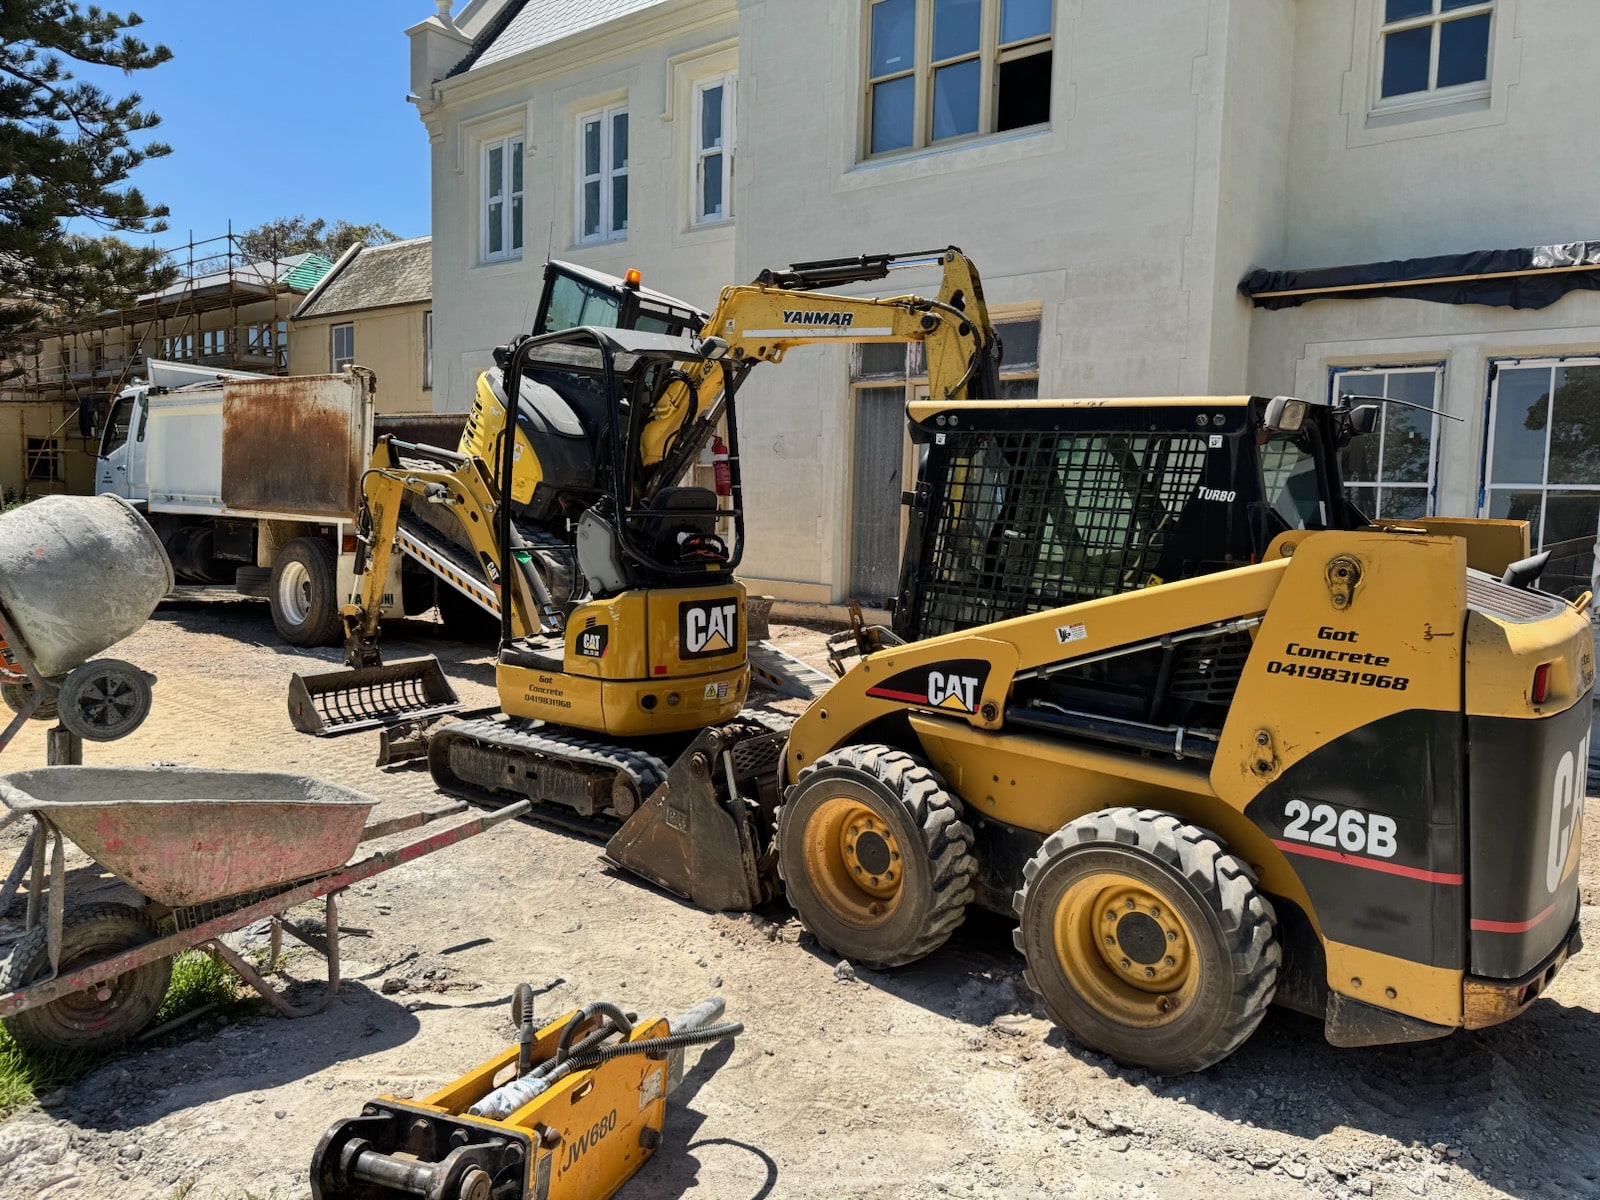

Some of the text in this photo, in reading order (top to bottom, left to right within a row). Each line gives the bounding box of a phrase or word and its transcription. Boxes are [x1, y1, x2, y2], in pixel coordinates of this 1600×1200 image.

[783, 311, 853, 326] YANMAR
[1198, 486, 1236, 502] TURBO
[487, 561, 500, 580] CAT
[686, 605, 736, 652] CAT
[1317, 626, 1359, 643] Got
[583, 633, 600, 650] CAT
[1286, 643, 1390, 667] Concrete
[539, 675, 553, 684] Got
[1266, 661, 1409, 691] 0419831968
[529, 684, 564, 696] Concrete
[928, 671, 979, 712] CAT
[524, 694, 572, 708] 0419831968
[1546, 724, 1592, 893] CA
[1283, 799, 1397, 858] 226B
[562, 1108, 617, 1172] JW680
